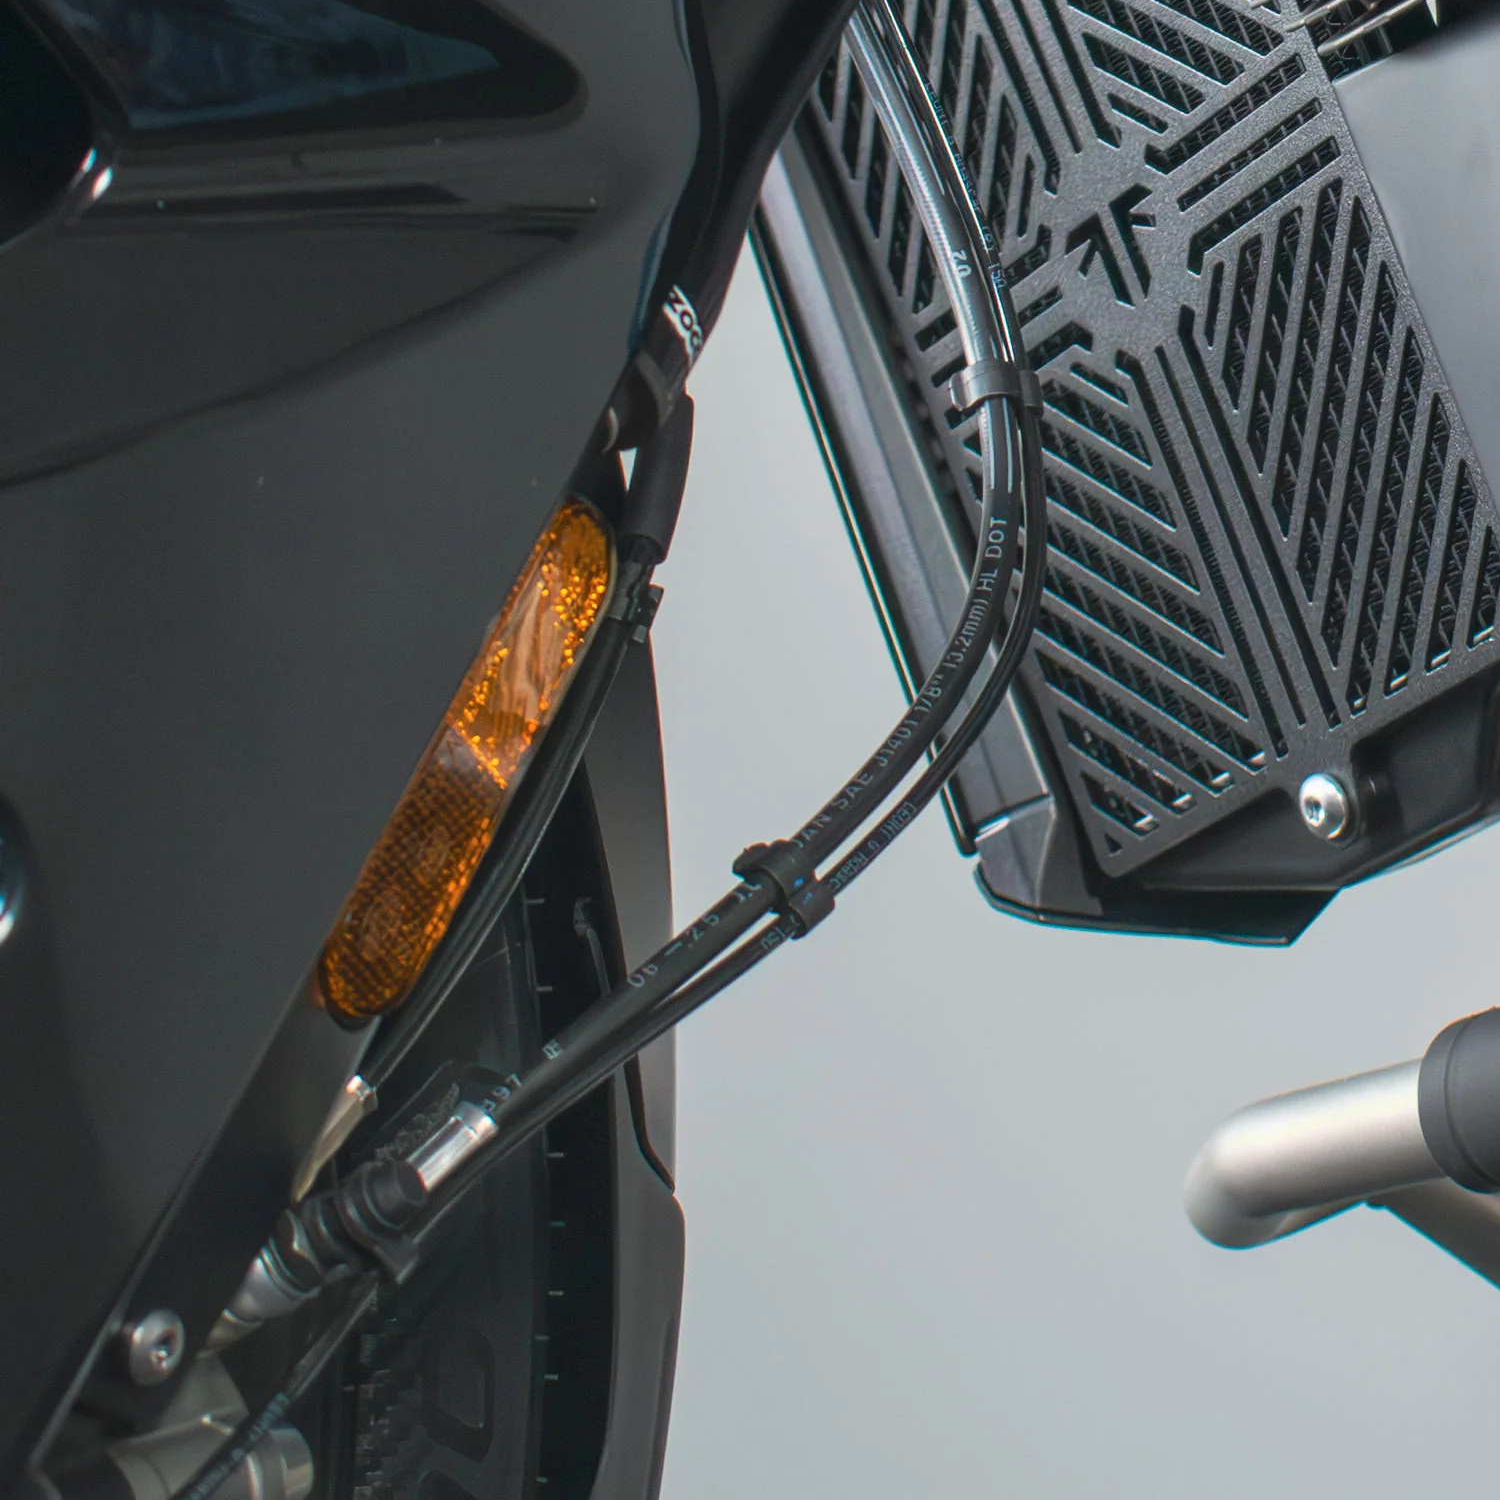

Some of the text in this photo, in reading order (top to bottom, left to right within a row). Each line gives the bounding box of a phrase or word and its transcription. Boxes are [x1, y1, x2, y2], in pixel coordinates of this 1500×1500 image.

[985, 516, 1008, 559] DOT
[976, 568, 998, 592] HL
[874, 718, 919, 768] J1401
[831, 773, 873, 810] SAE
